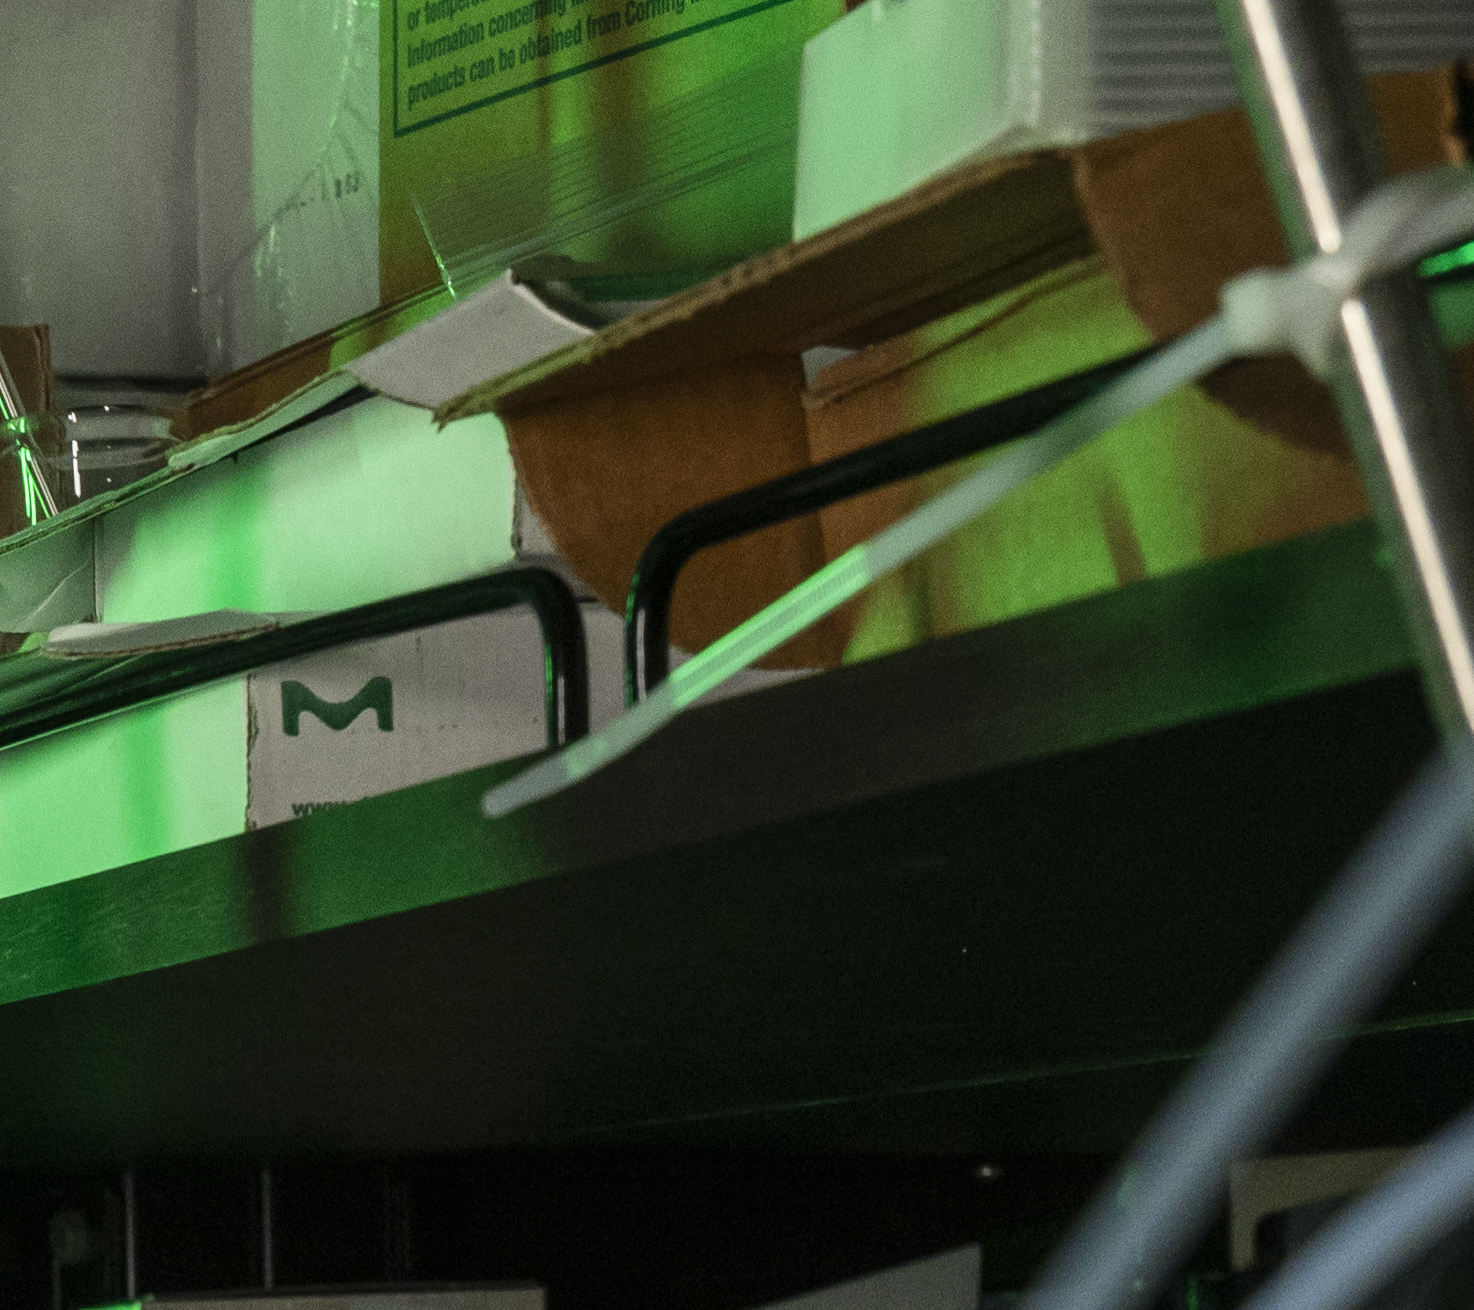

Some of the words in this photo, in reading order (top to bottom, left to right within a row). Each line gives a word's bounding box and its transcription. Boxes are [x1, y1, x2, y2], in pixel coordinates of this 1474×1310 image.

[407, 22, 484, 68] Information
[408, 65, 466, 112] products
[469, 57, 494, 82] can
[498, 48, 515, 71] be
[520, 18, 582, 64] obtained
[586, 11, 621, 39] from
